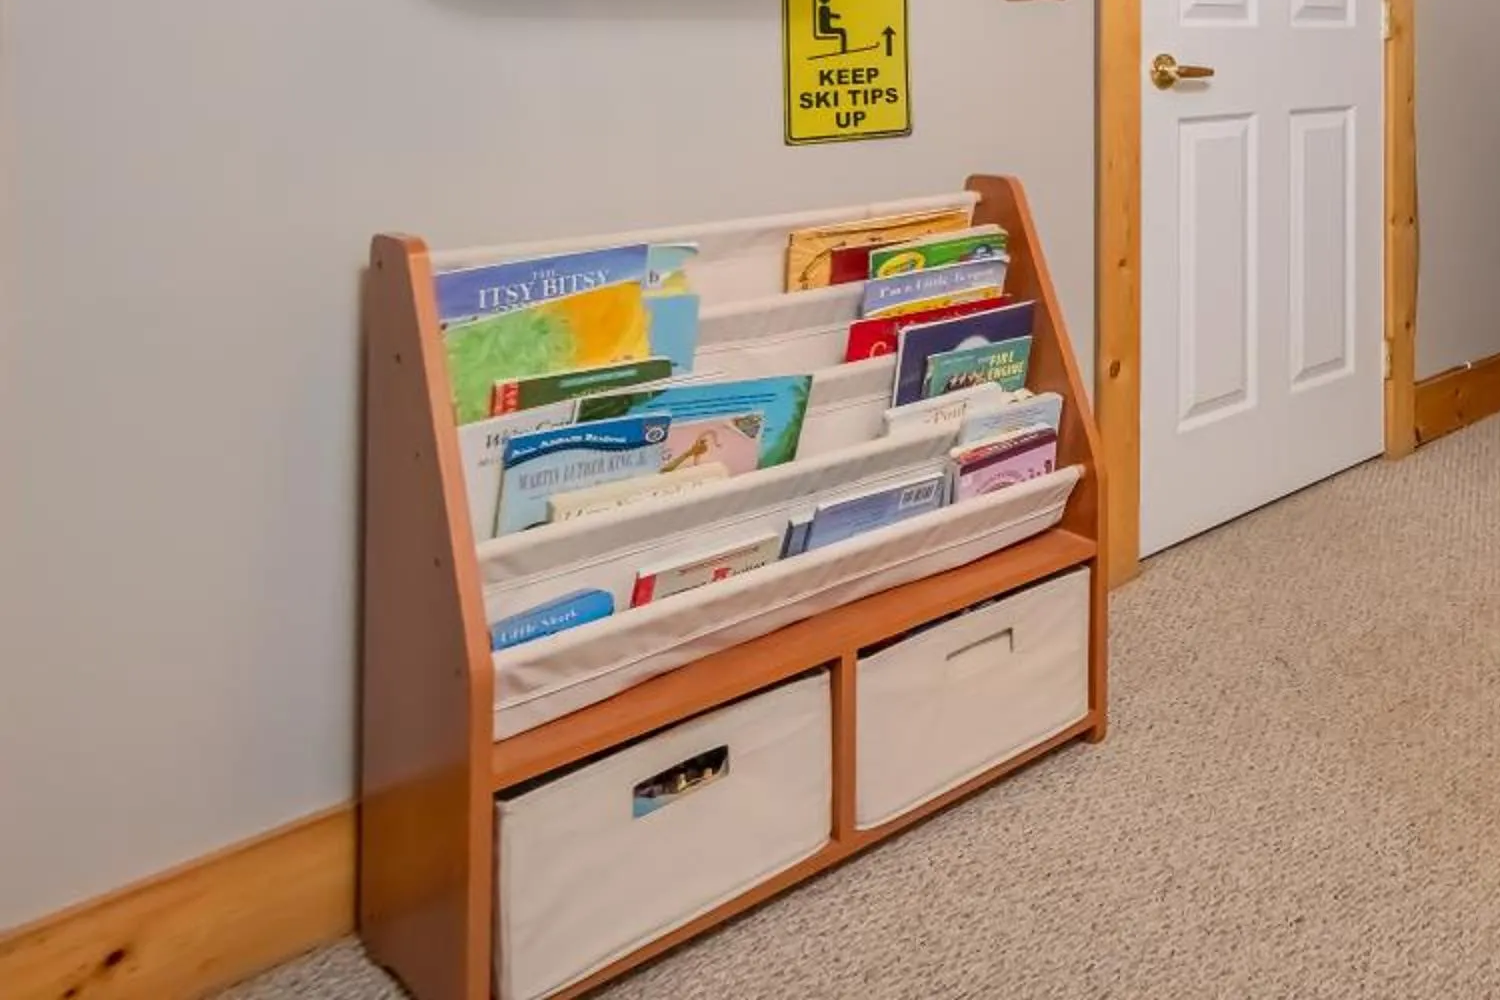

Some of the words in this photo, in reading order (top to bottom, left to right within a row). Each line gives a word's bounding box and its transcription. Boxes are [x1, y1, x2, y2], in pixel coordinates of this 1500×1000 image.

[819, 67, 880, 86] KEEP
[800, 90, 839, 109] SKI
[848, 87, 899, 105] TIPS
[835, 111, 866, 129] UP
[479, 280, 536, 309] ITSY
[543, 269, 610, 297] BITSY
